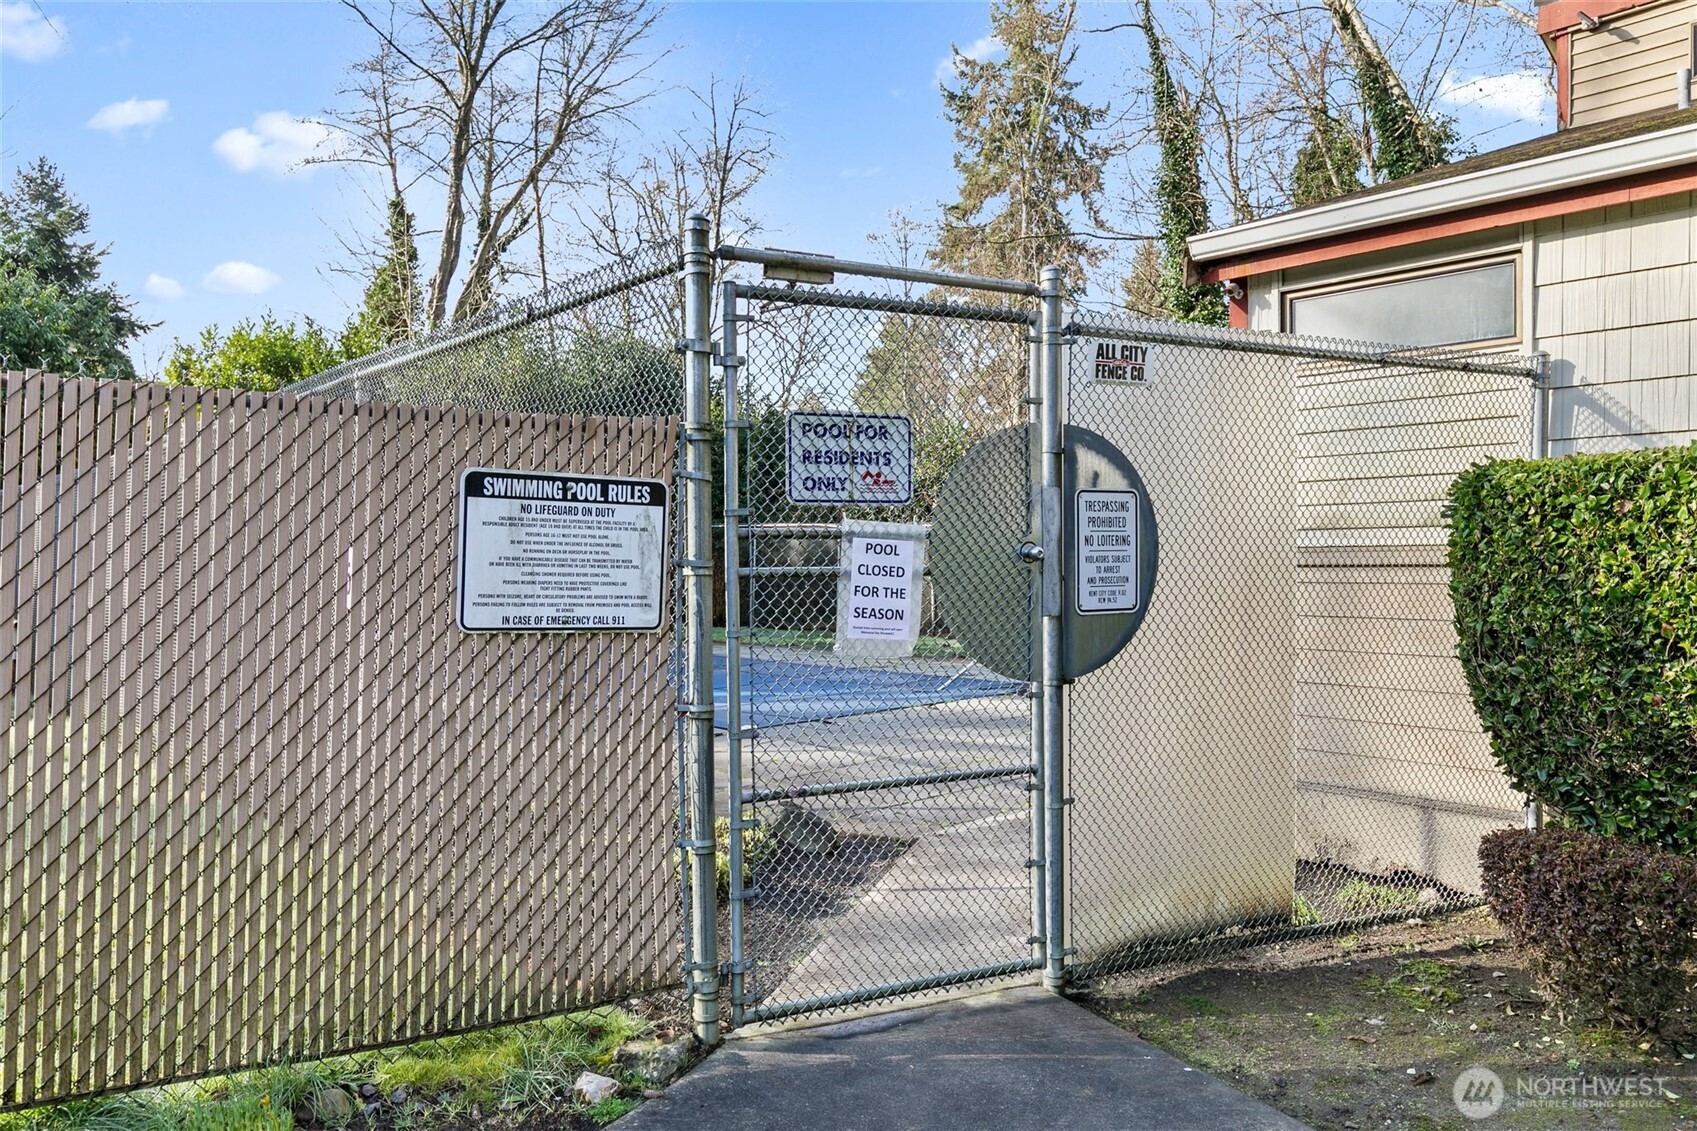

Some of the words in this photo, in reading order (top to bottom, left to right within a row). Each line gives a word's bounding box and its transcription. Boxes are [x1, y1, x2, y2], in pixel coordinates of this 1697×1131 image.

[1096, 343, 1117, 360] ALL
[1121, 345, 1148, 362] CITY
[1096, 364, 1127, 380] FENCE
[1131, 366, 1147, 382] CO.
[802, 423, 850, 439] POOL
[856, 424, 888, 440] FOR
[802, 450, 891, 466] RESIDENTS
[483, 477, 562, 499] SWIMMING
[566, 482, 604, 501] POOL
[608, 484, 650, 503] RULES
[803, 476, 848, 492] ONLY
[520, 504, 532, 514] NO
[535, 504, 579, 516] LIFEGUARD
[581, 506, 592, 517] ON
[595, 507, 616, 518] DUTY
[1085, 500, 1129, 512] TRESPASSING
[1088, 517, 1126, 528] PROHIBITED
[1085, 535, 1093, 546] NO
[1097, 535, 1130, 546] LOITERING
[865, 543, 900, 556] POOL
[1112, 555, 1130, 563] SUBJECT
[858, 564, 905, 577] CLOSED
[1098, 576, 1129, 584] PROSECUTION
[854, 585, 879, 597] FOR
[883, 587, 906, 599] THE
[853, 607, 904, 620] SEASON
[502, 616, 510, 625] IN
[512, 616, 532, 625] CASE
[534, 616, 544, 625] OF
[546, 616, 591, 625] EMEGENCY
[592, 616, 610, 625] CALL
[612, 616, 625, 625] 911
